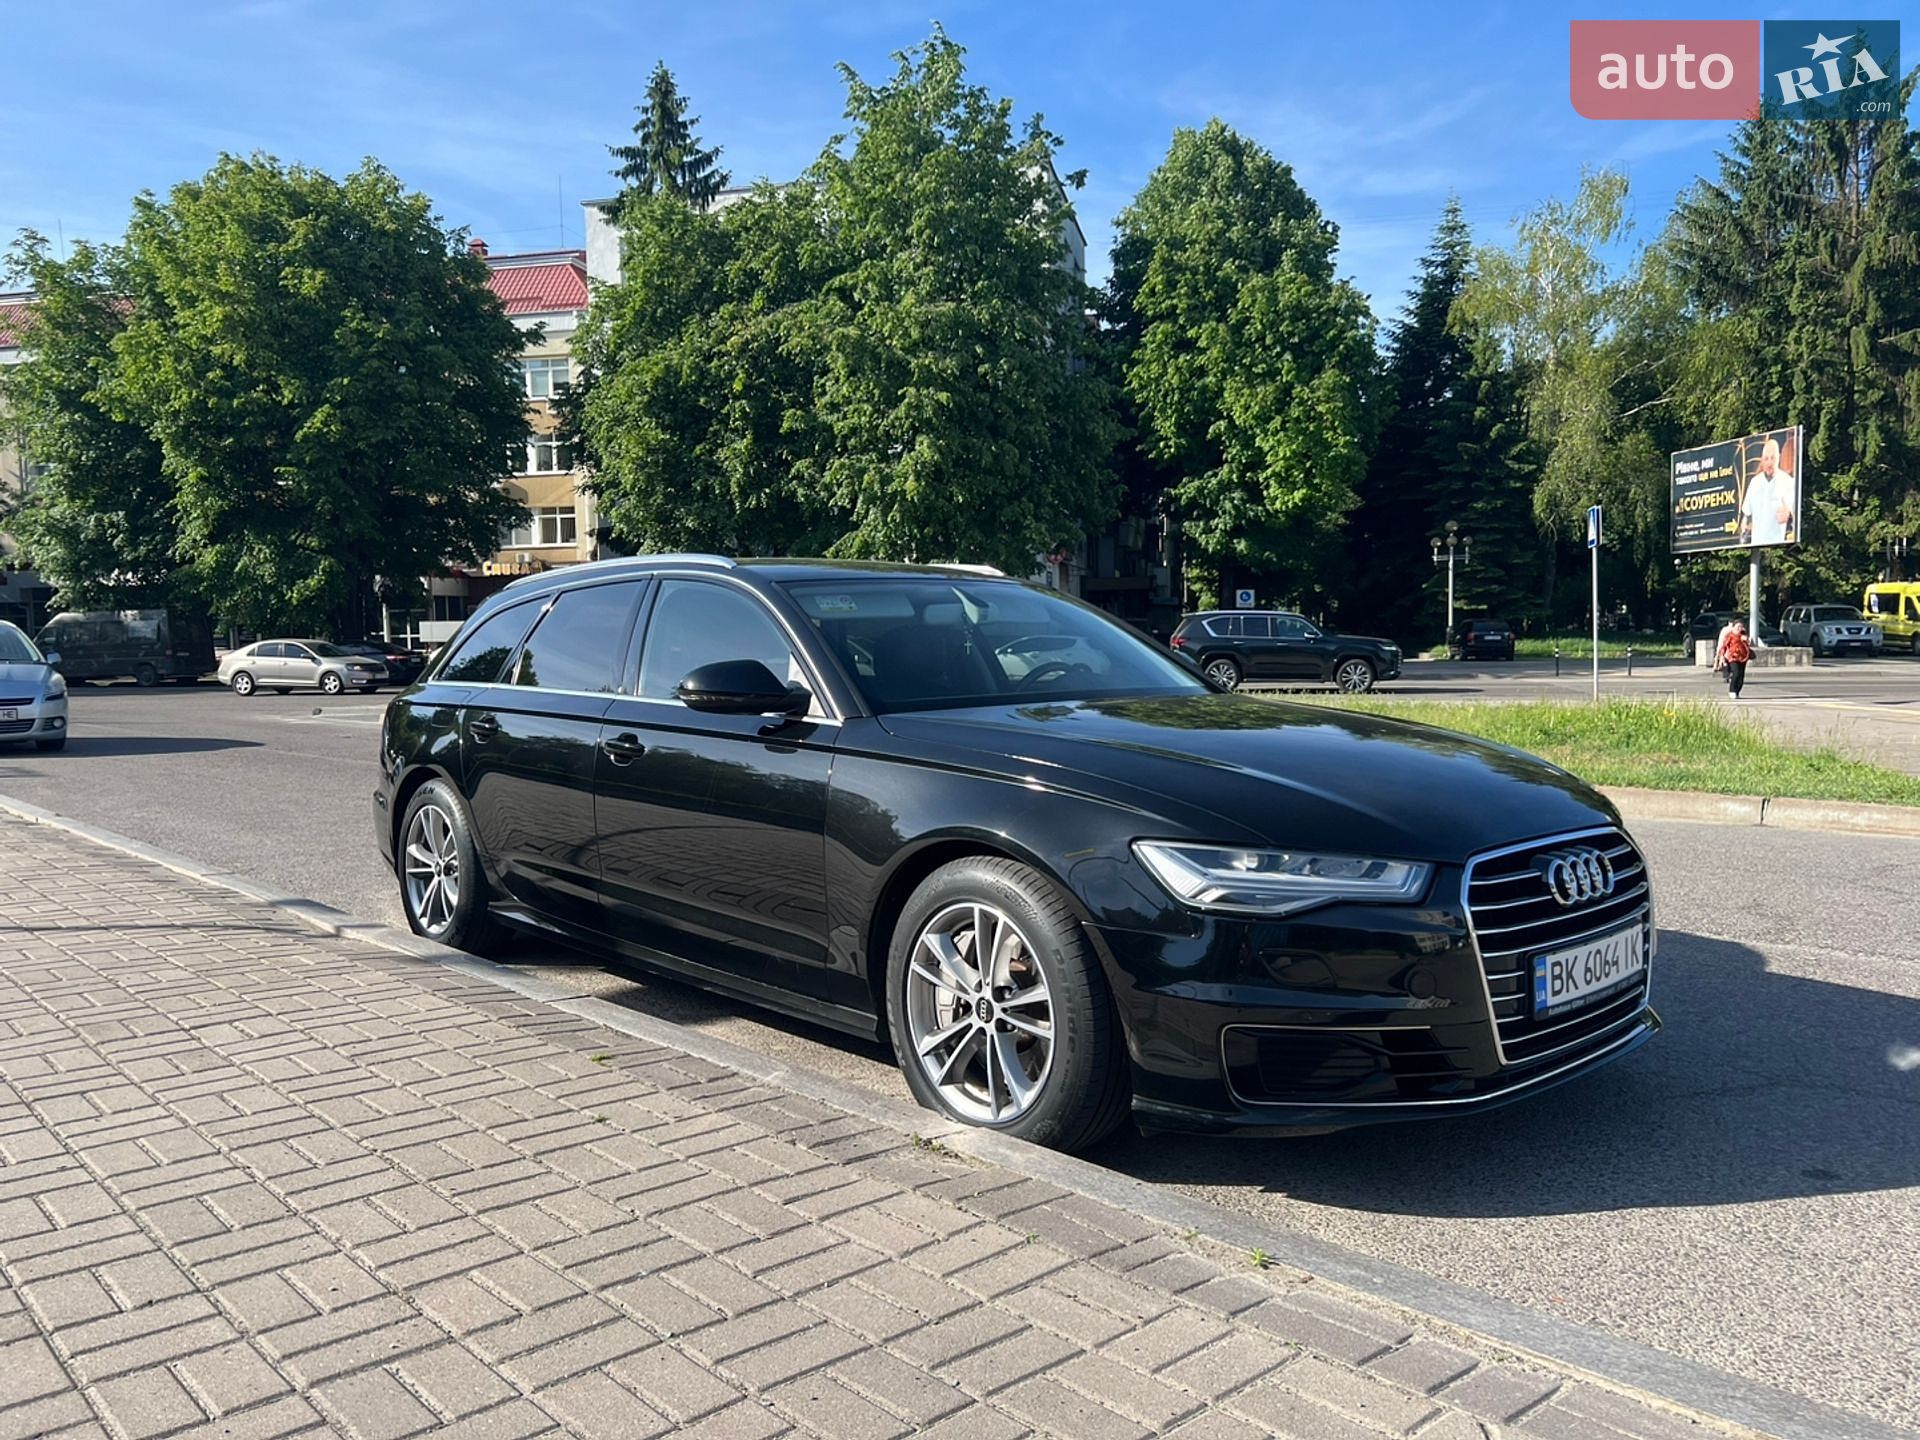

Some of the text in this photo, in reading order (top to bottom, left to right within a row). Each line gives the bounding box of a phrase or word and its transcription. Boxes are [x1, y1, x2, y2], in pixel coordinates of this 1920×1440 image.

[1551, 955, 1579, 997] BK
[1584, 941, 1619, 986] 6064
[1625, 932, 1640, 970] IK
